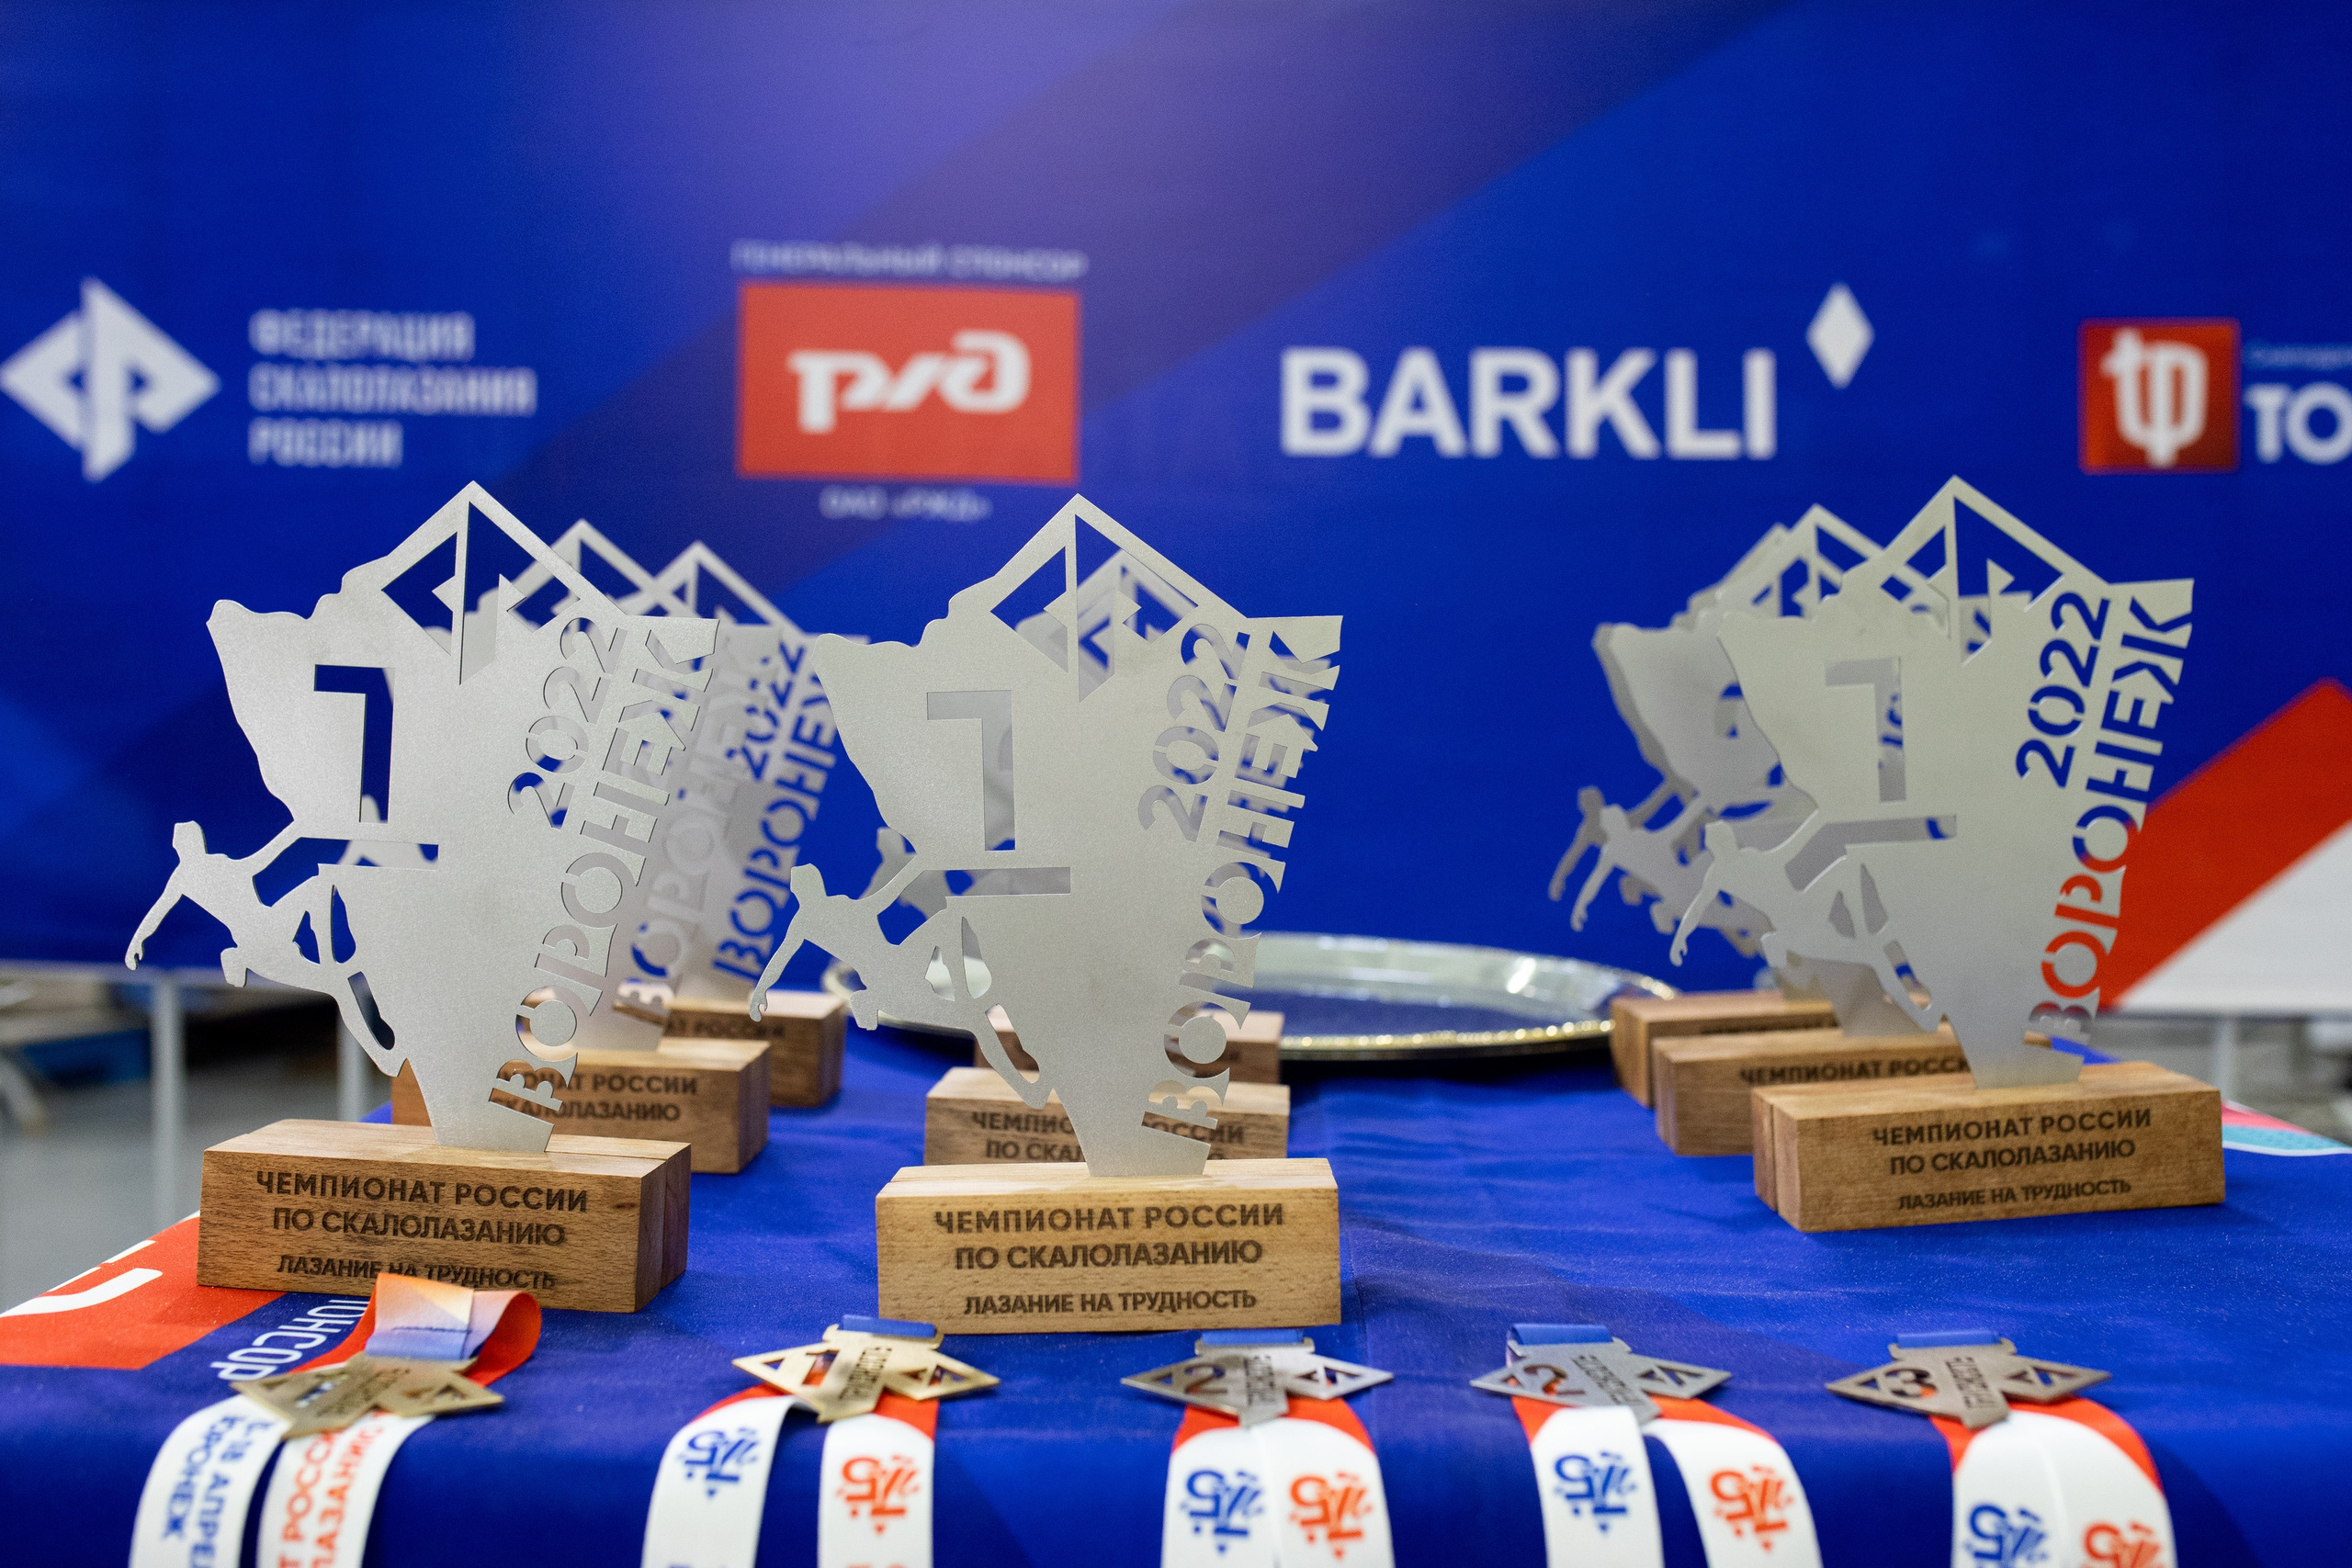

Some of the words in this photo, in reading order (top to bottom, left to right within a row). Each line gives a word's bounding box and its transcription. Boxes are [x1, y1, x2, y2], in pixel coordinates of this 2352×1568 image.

[1281, 347, 1777, 459] BARKLI
[2016, 592, 2111, 788] 2022
[508, 616, 627, 829] 2022
[1138, 624, 1250, 842] 2022
[2029, 597, 2192, 1053] ВОРОНЕЖ
[489, 628, 713, 1124] ВОРОНЕЖ
[592, 1073, 698, 1097] РОССИИ
[1871, 1117, 2033, 1148] ЧЕМПИОНАТ
[2039, 1107, 2153, 1137] РОССИИ
[1889, 1153, 1926, 1177] ПО
[1930, 1139, 2137, 1173] СКАЛОЛАЗАНИЮ
[255, 1171, 447, 1207] ЧЕМПИОНАТ
[455, 1185, 590, 1214] РОССИИ
[1897, 1188, 1986, 1212] ЛАЗАНИЕ
[1990, 1186, 2018, 1205] НА
[2020, 1178, 2133, 1204] ТРУДНОСТЬ
[274, 1206, 315, 1232] ПО
[321, 1210, 567, 1247] СКАЛОЛАЗАНИЮ
[935, 1207, 1132, 1234] ЧЕМПИОНАТ
[1145, 1203, 1284, 1229] РОССИИ
[277, 1254, 382, 1280] ЛАЗАНИЕ
[423, 1263, 557, 1292] ТРУДНОСТЬ
[955, 1246, 1000, 1270] ПО
[1007, 1239, 1262, 1269] СКАЛОЛАЗАНИЮ
[965, 1293, 1073, 1314] ЛАЗАНИЕ
[1080, 1292, 1115, 1311] НА
[1118, 1289, 1258, 1312] ТРУДНОСТЬ
